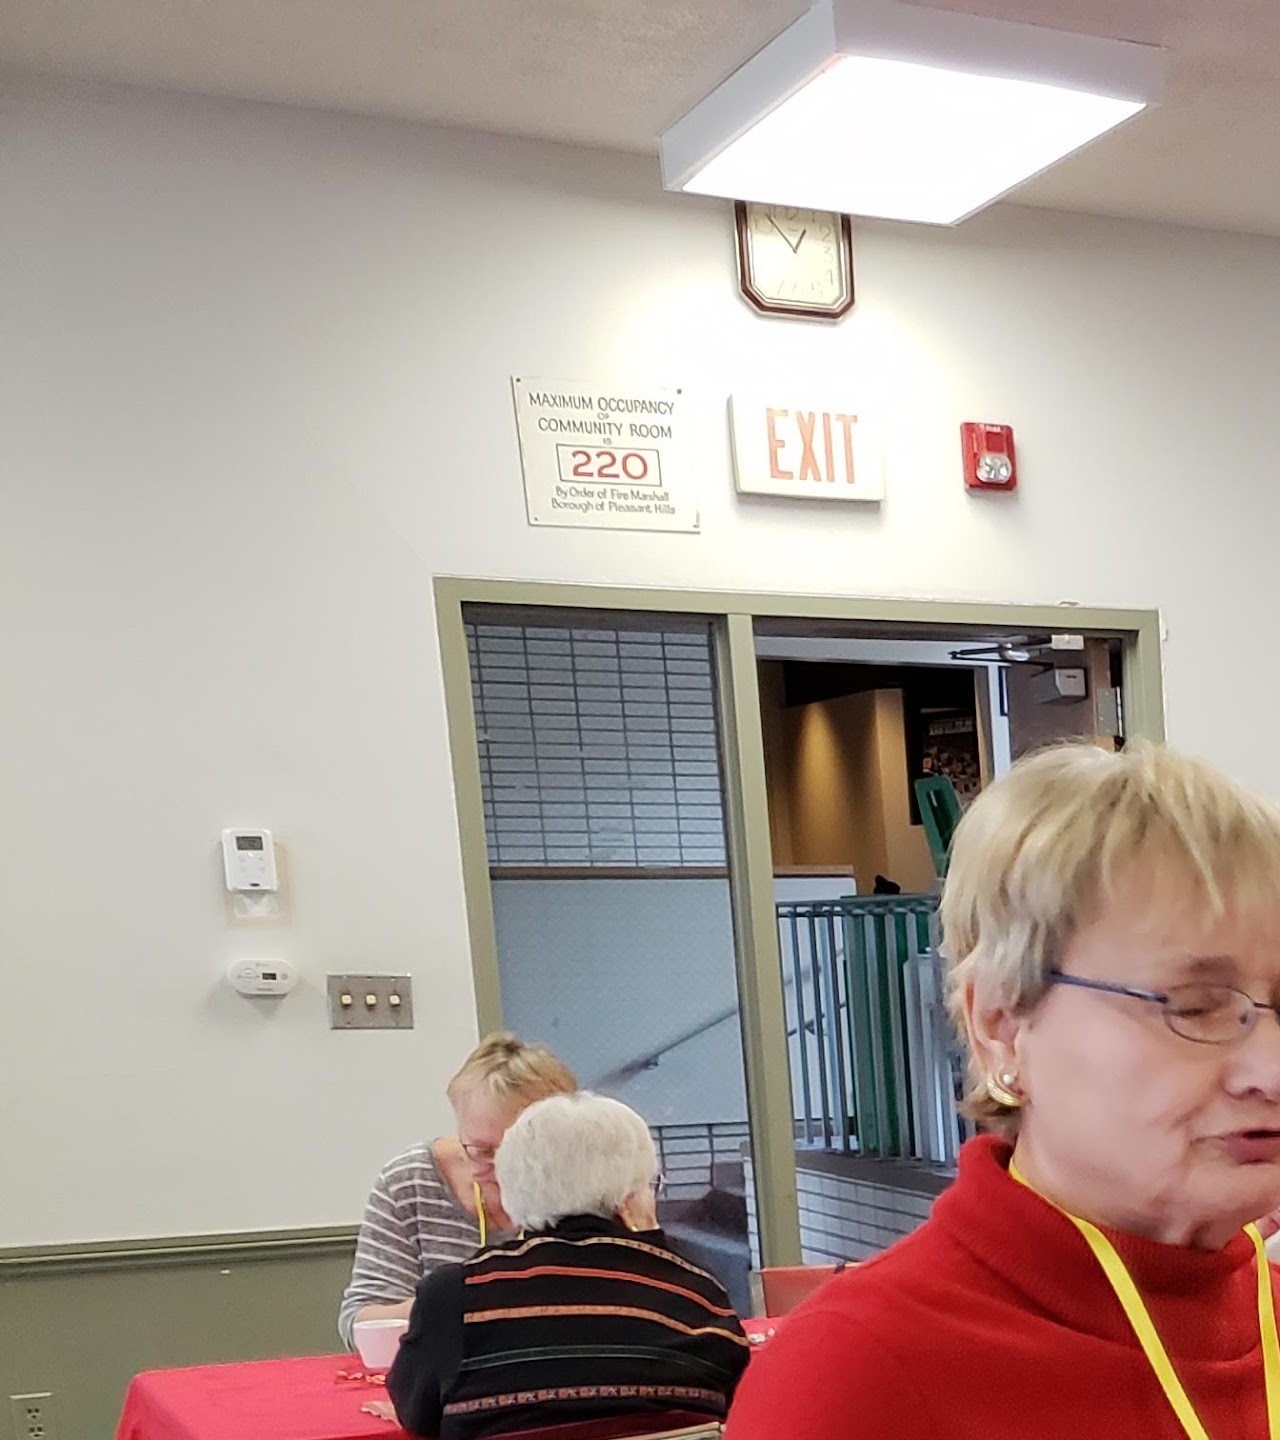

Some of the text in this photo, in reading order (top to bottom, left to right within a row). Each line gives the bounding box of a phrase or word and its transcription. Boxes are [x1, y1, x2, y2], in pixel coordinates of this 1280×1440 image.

[528, 392, 675, 416] MAXIMUM OCCUPANCY
[597, 412, 610, 421] OF
[537, 417, 673, 439] COMMUNITY ROOM
[766, 407, 858, 484] EXIT
[571, 450, 649, 480] 220
[555, 486, 669, 502] By Order of Fire Marshall
[551, 498, 676, 515] Borough of Pleasant Hills
